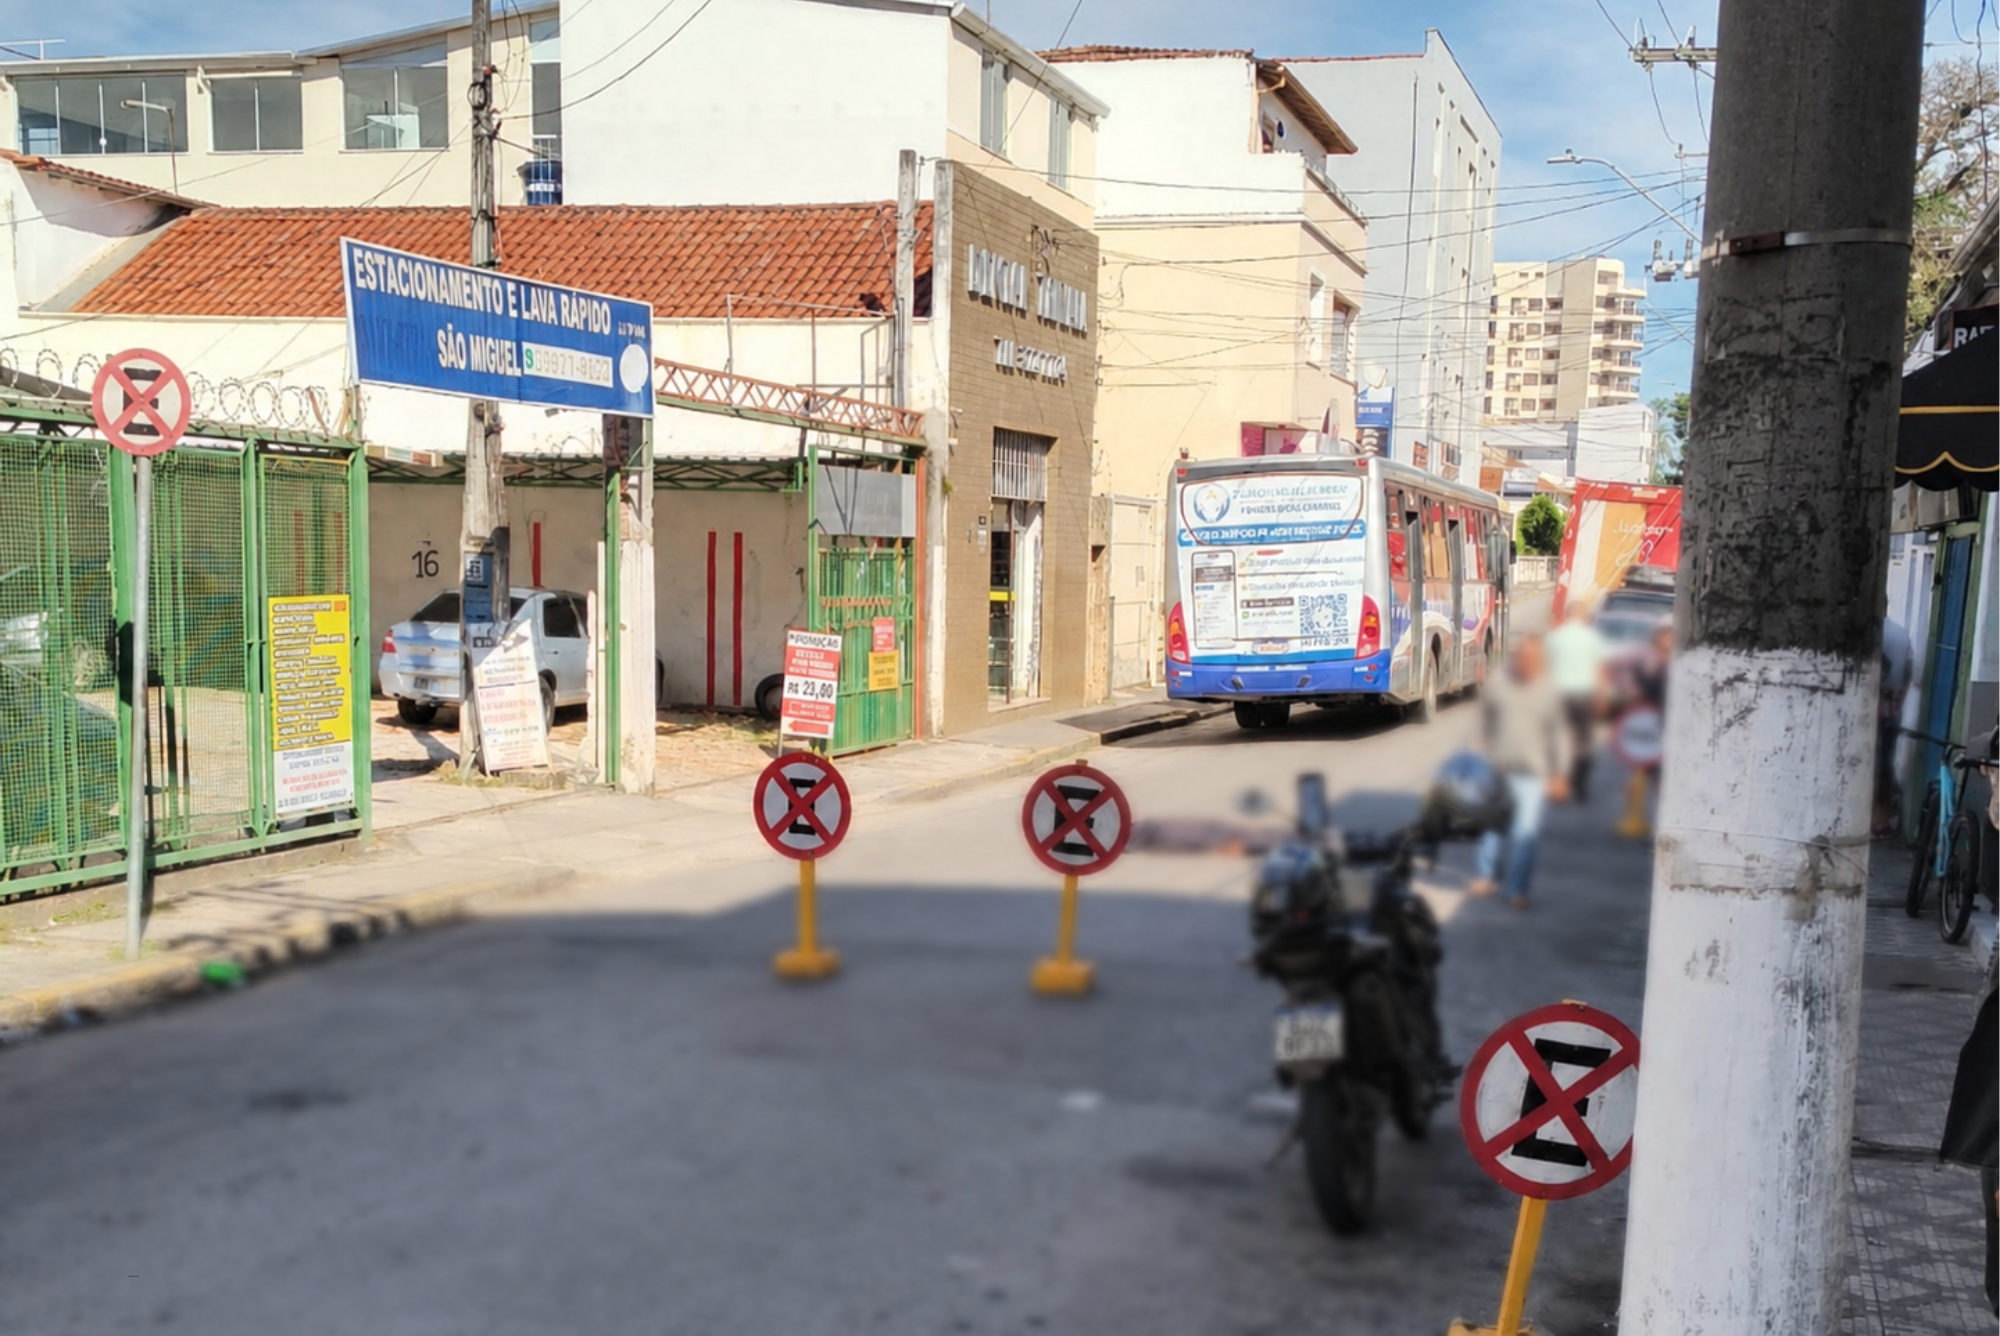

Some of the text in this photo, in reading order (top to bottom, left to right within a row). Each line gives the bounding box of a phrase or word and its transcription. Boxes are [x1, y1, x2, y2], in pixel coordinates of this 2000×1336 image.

[353, 247, 504, 316] ESTACIONAMENTO
[507, 281, 518, 318] E
[520, 284, 558, 326] LAVA
[560, 291, 611, 336] RÁPIDO
[436, 322, 467, 371] SÃO
[469, 333, 522, 377] MIGUEL
[411, 549, 440, 579] 16
